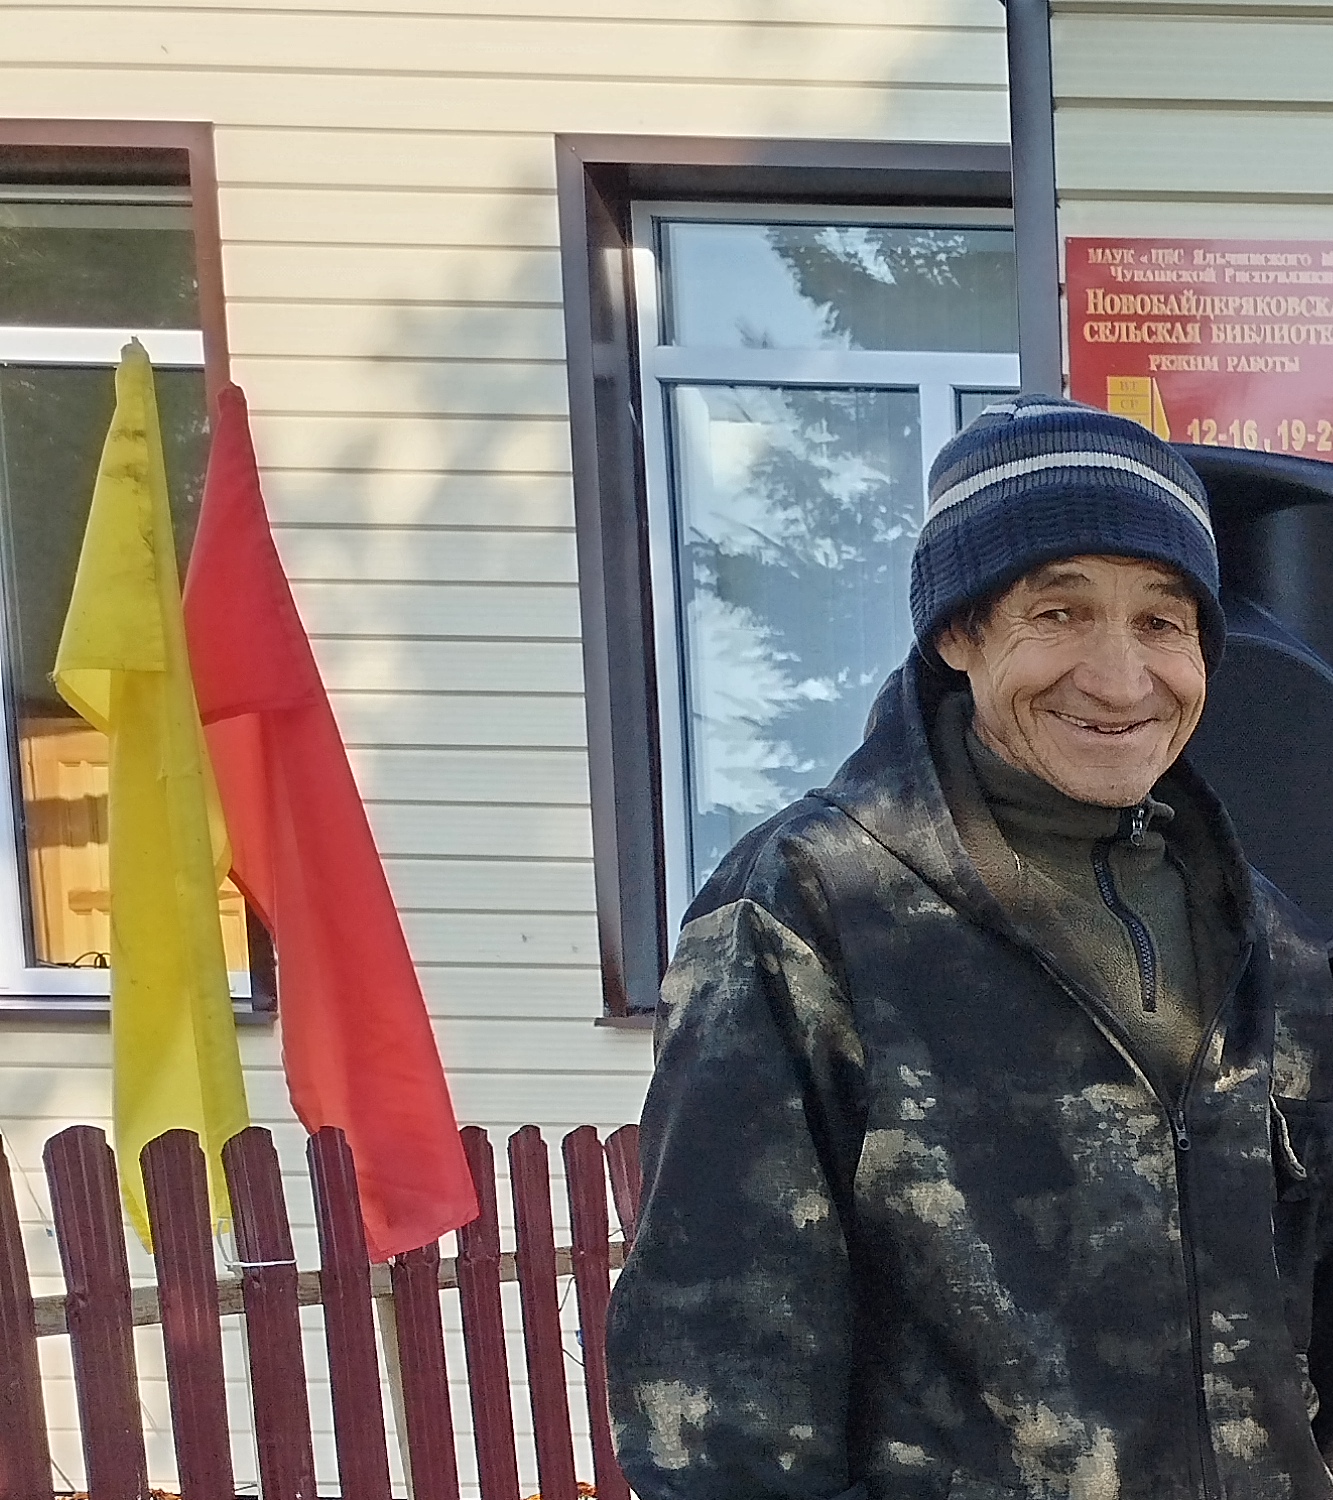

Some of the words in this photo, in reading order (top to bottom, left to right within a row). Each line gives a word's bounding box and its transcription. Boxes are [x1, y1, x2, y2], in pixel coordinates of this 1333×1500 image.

[1083, 321, 1200, 344] СЕЛЬСКАЯ
[1148, 354, 1219, 372] РЕЖИМ
[1226, 354, 1300, 373] РАБОТЫ
